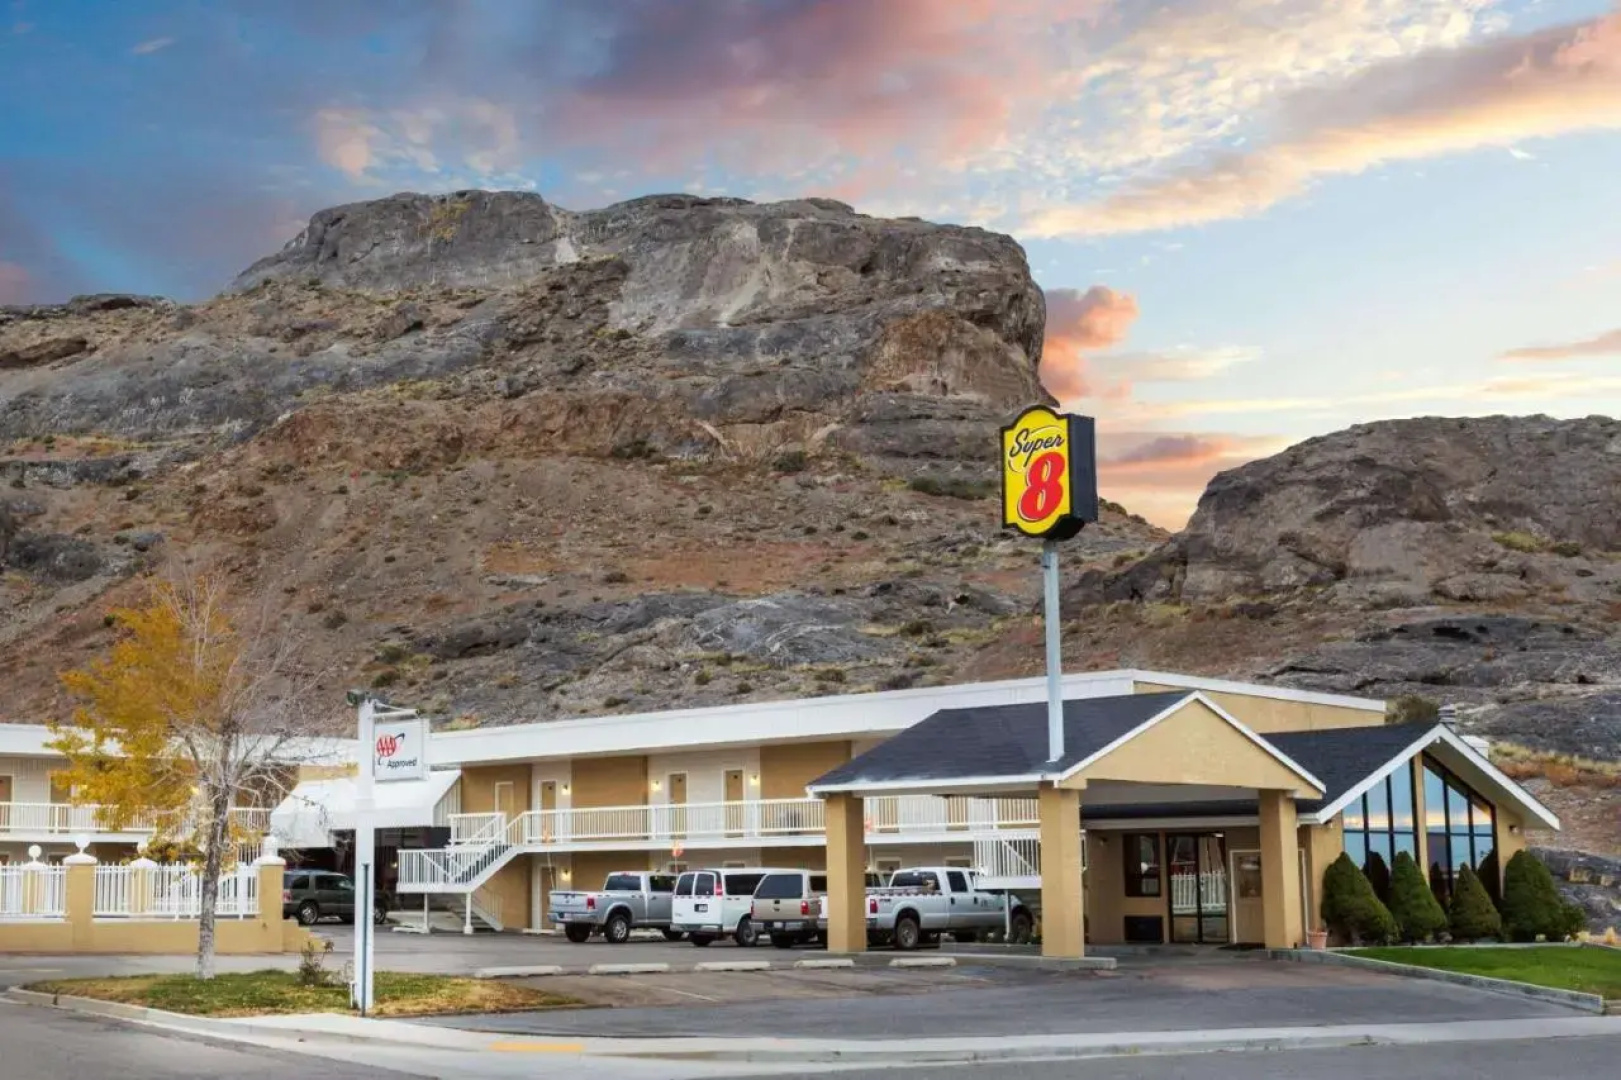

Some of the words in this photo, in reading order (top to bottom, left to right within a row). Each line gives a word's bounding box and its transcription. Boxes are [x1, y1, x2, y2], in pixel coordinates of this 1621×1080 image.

[1009, 428, 1065, 468] Super
[1017, 451, 1066, 523] 8
[376, 734, 397, 757] AAA
[387, 757, 418, 769] Approved
